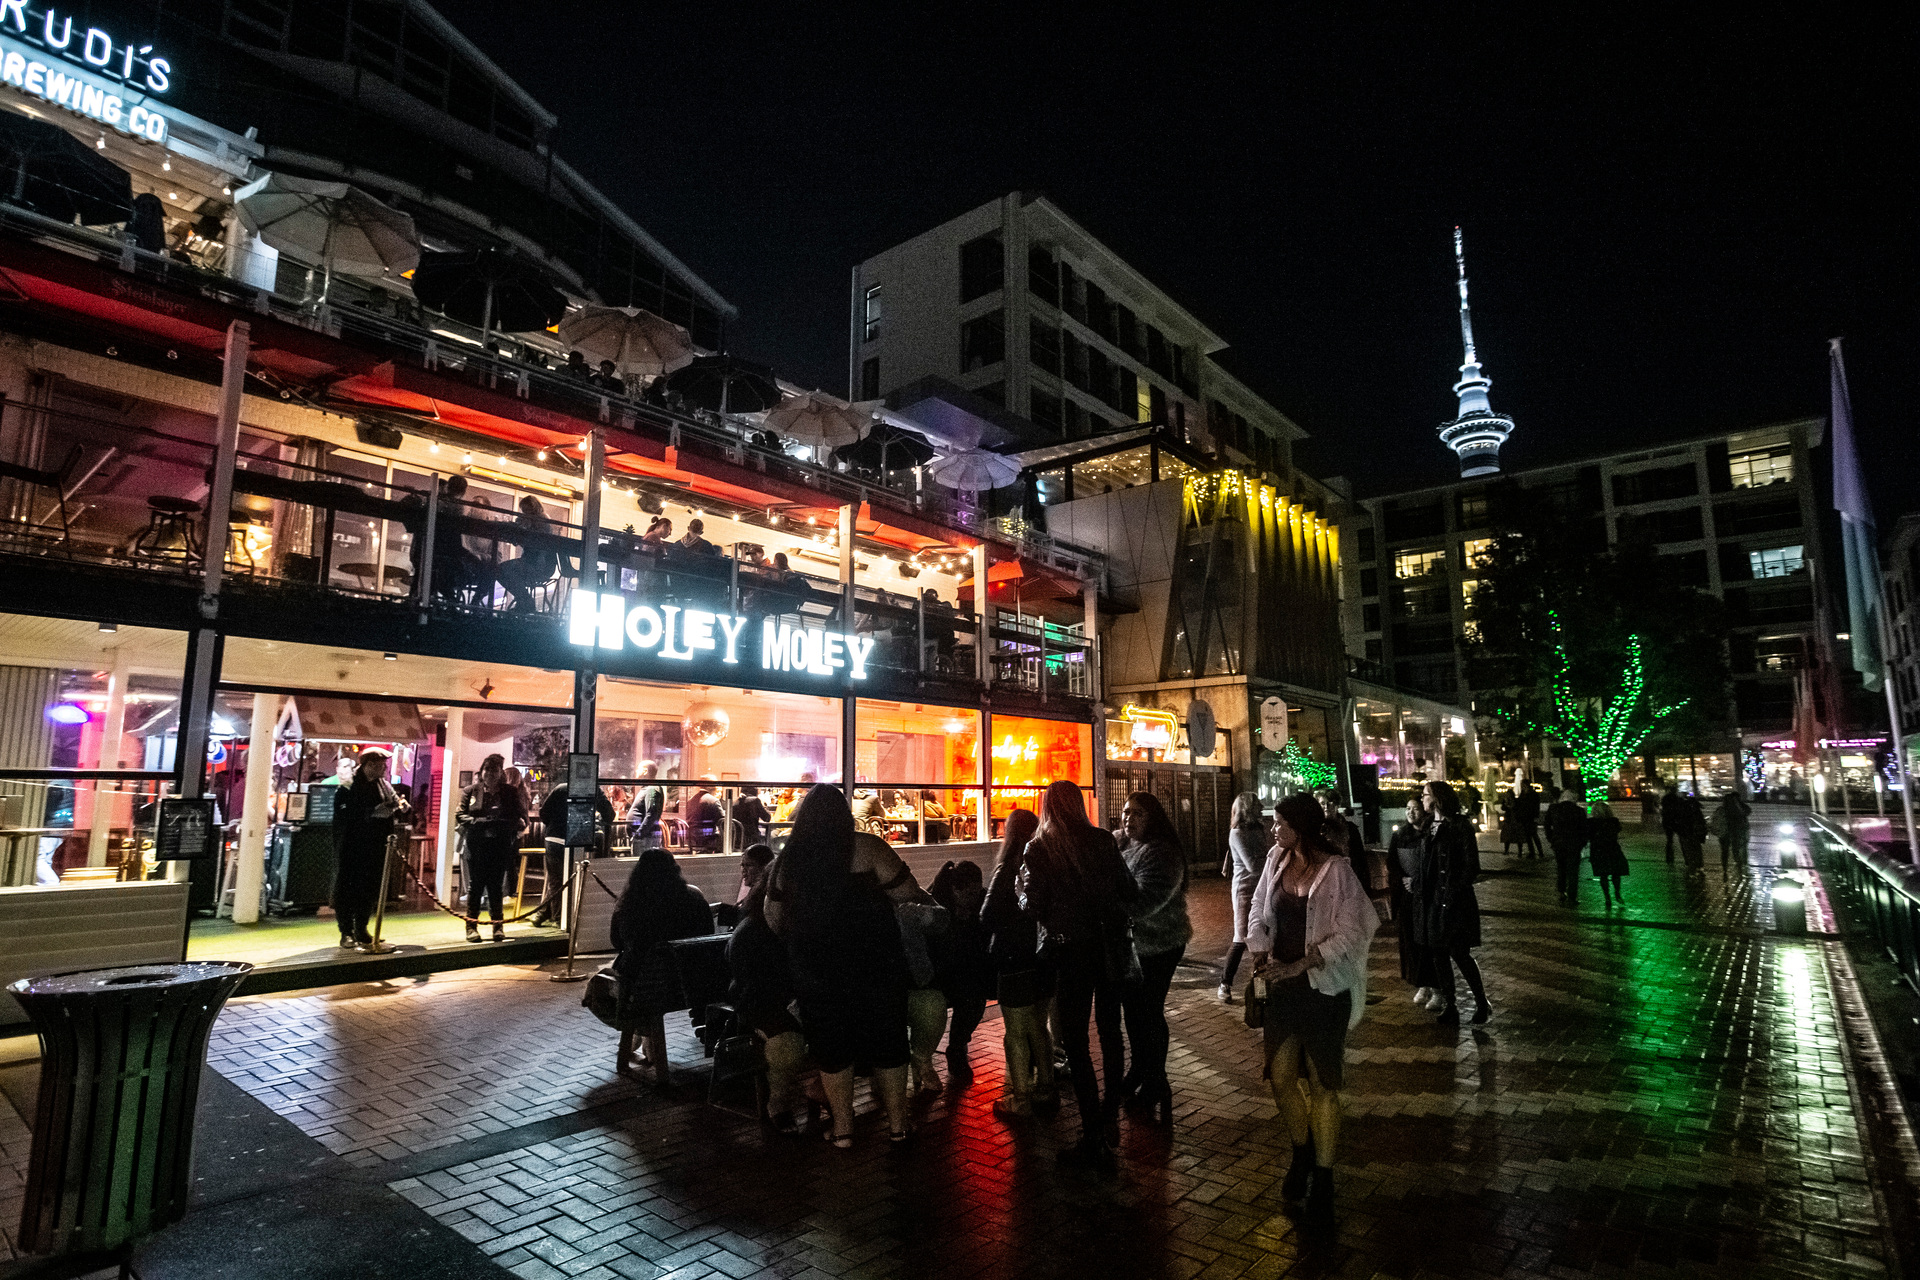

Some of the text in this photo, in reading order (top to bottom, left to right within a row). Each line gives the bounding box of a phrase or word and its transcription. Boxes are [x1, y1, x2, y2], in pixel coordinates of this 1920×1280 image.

[0, 46, 166, 142] REWING CO
[570, 588, 875, 680] HOLEY MOLEY
